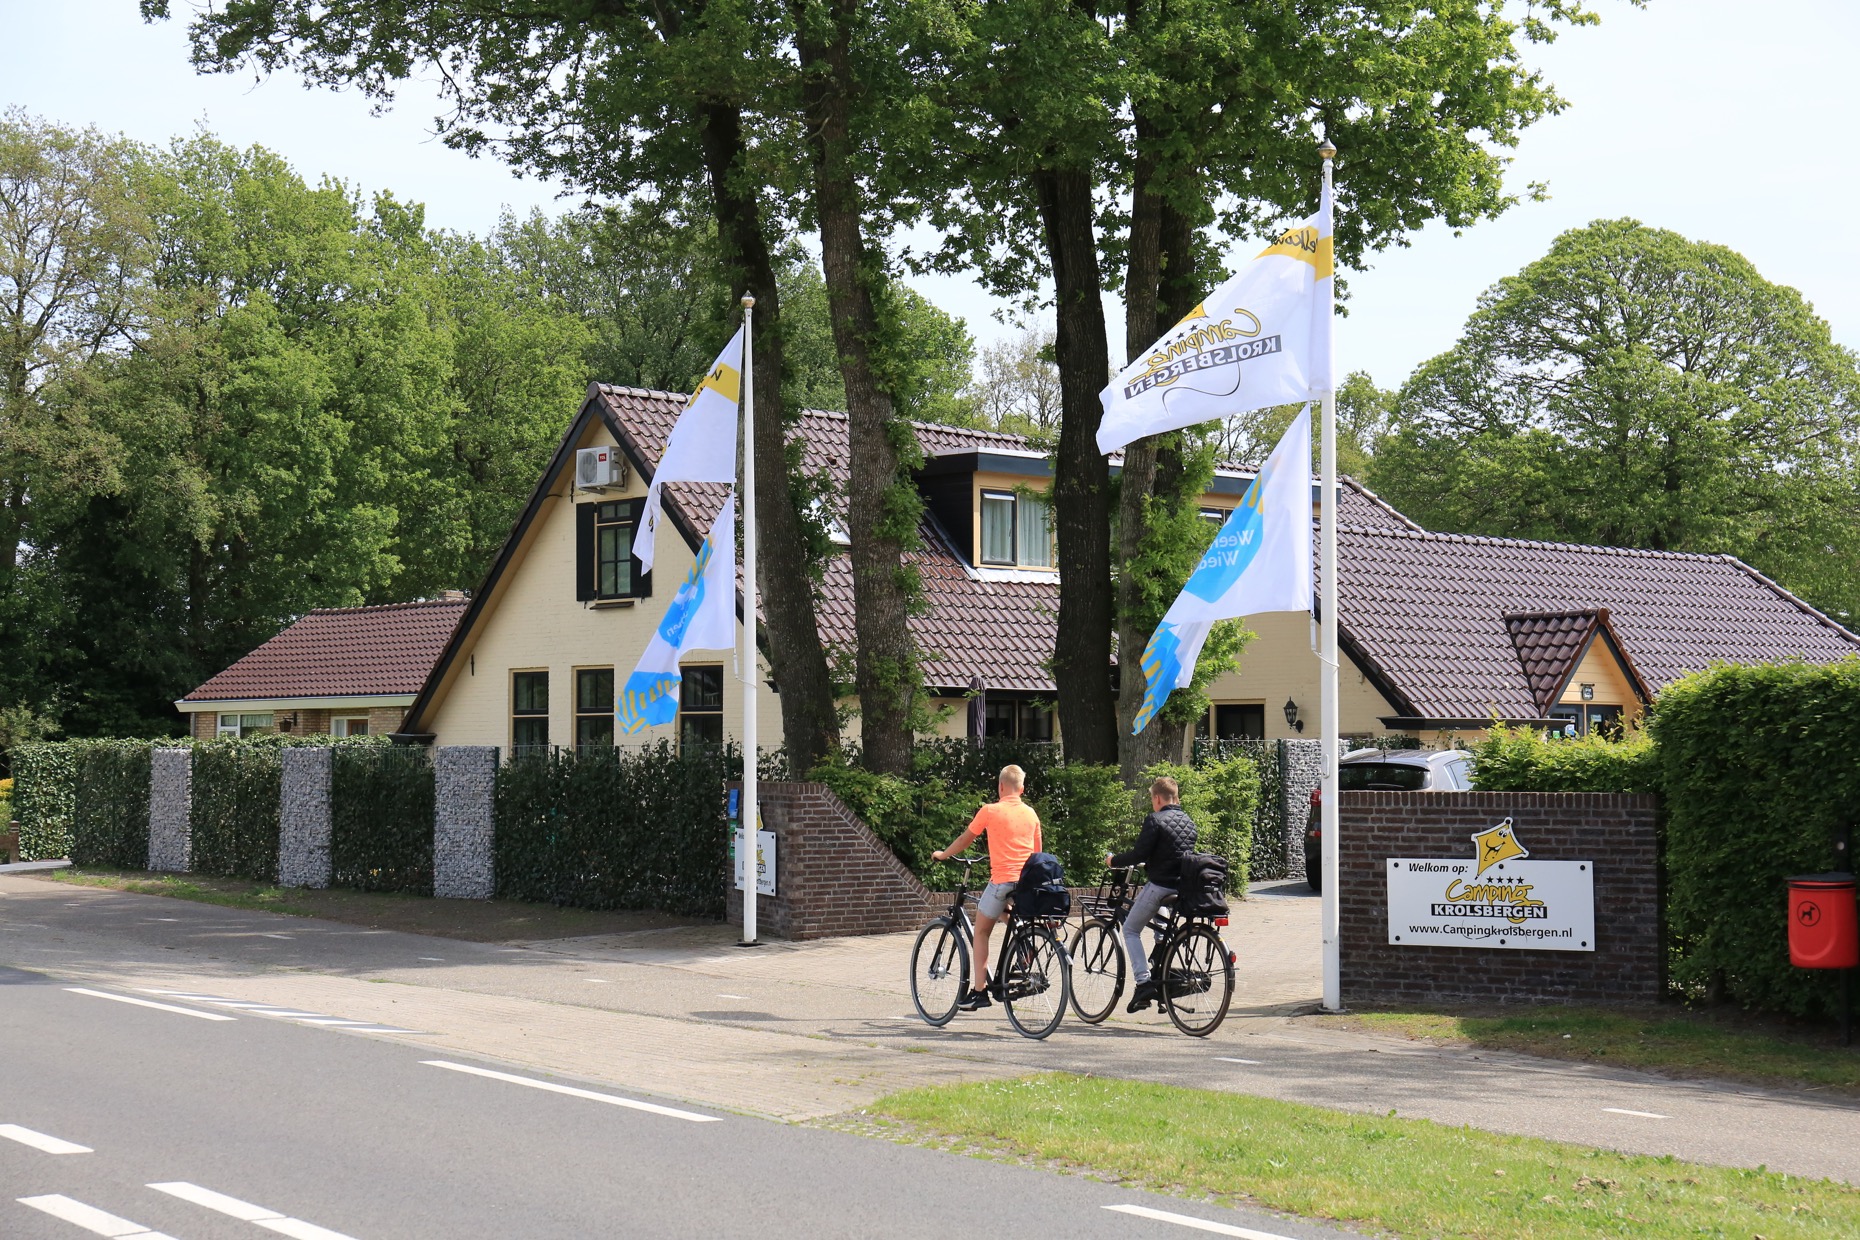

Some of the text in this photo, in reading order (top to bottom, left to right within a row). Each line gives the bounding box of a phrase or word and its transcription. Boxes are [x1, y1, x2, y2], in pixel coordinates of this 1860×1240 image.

[1408, 862, 1469, 875] Welkom op:
[1445, 878, 1544, 924] Camping
[1434, 904, 1545, 918] KROLSBERGEN
[1408, 924, 1573, 939] www.Campingkrolsbergen.nl
